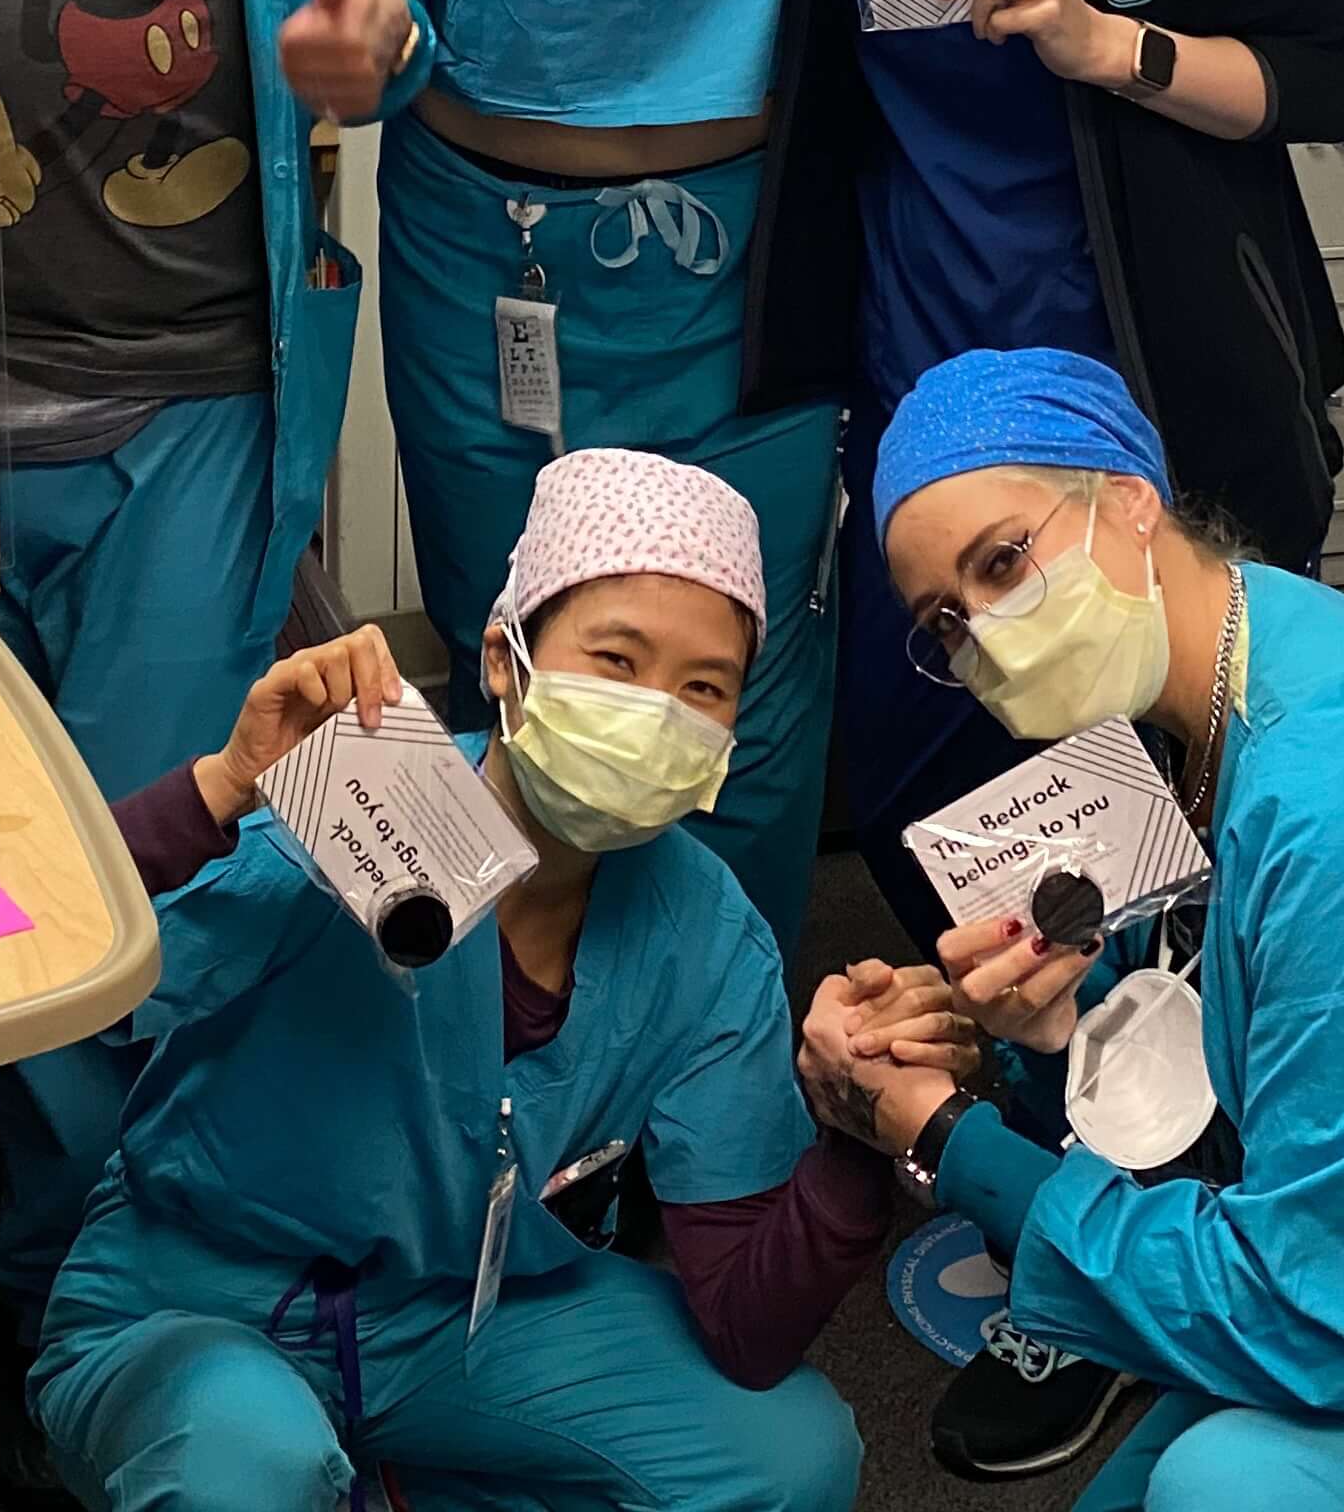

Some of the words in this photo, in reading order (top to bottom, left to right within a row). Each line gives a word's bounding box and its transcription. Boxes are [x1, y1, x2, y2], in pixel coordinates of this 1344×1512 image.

[510, 321, 529, 344] E
[345, 778, 385, 820] you
[978, 774, 1073, 832] Bedrock
[1038, 820, 1064, 839] to
[1067, 794, 1111, 830] you
[376, 818, 396, 843] to
